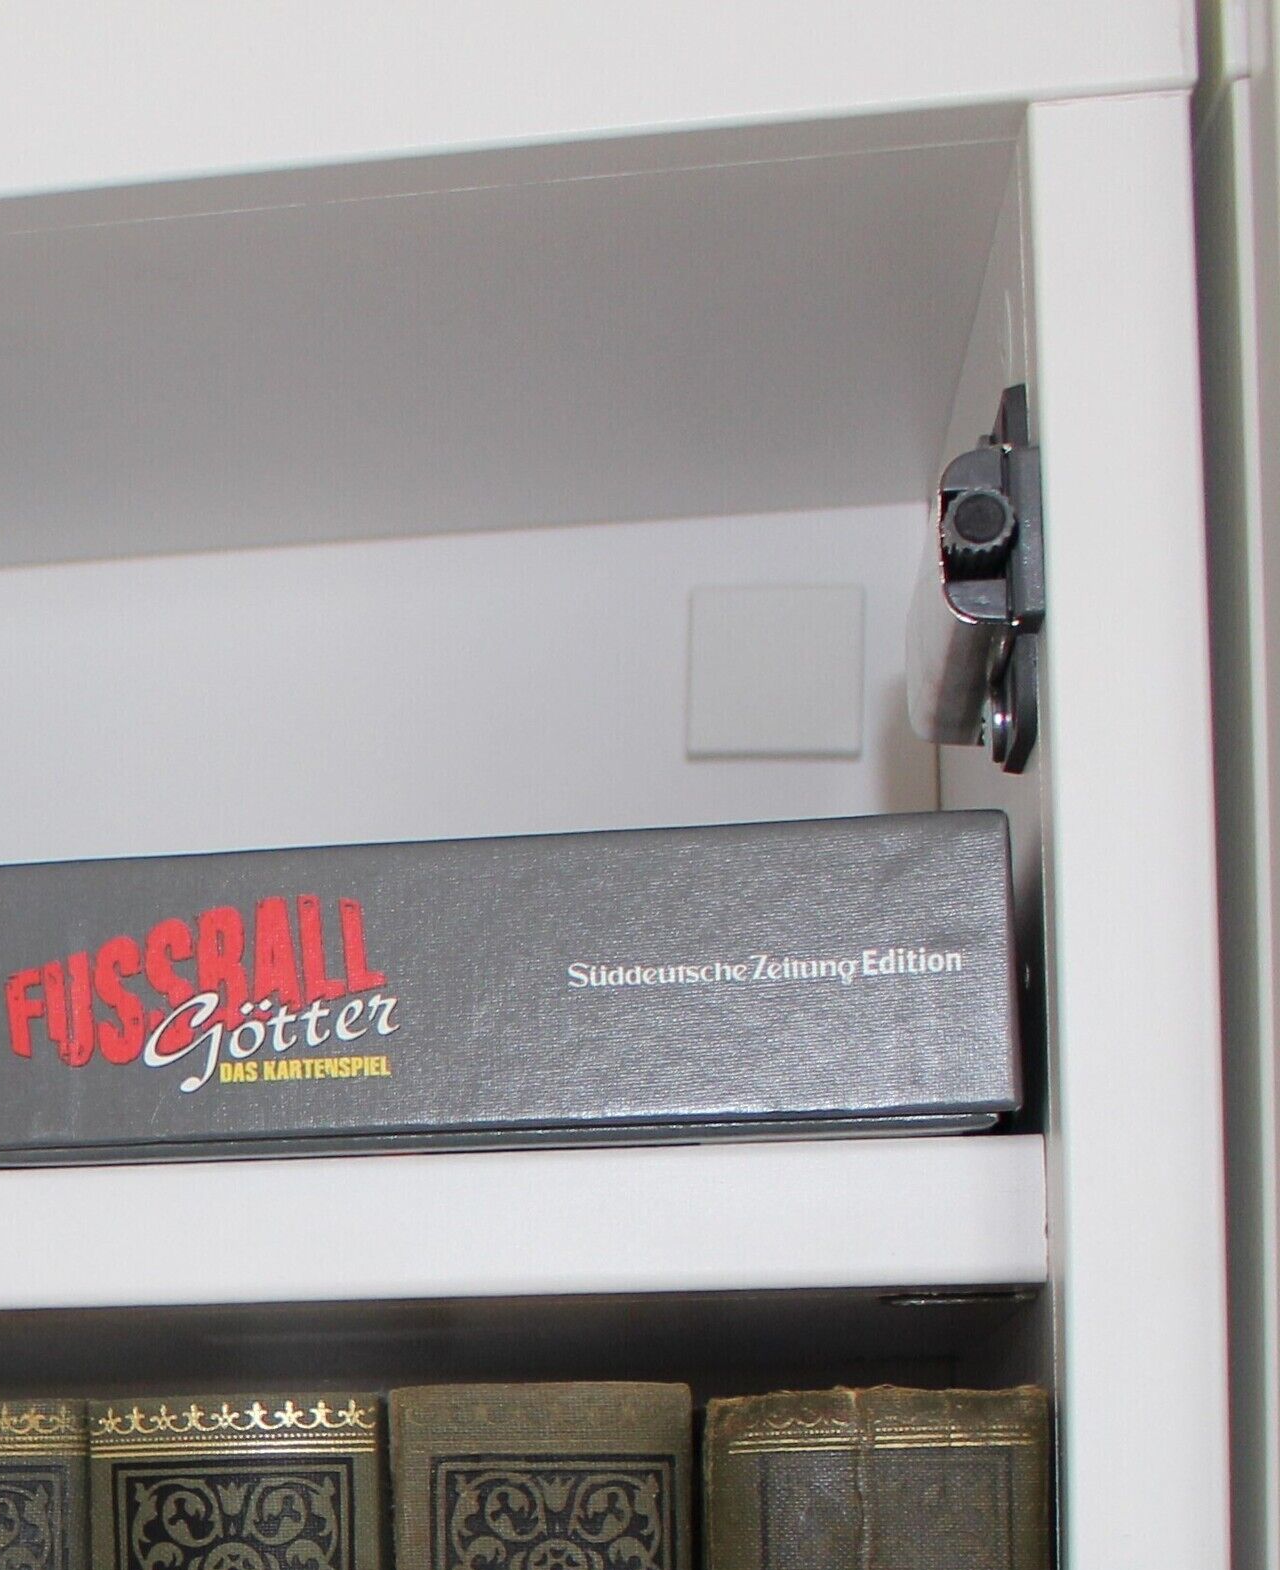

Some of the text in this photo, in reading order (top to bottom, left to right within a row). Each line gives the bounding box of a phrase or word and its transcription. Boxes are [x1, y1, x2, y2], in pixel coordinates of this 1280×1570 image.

[3, 893, 388, 1068] FUSSBALL
[568, 948, 964, 988] Süddeutsche Zeitung Edition
[142, 992, 401, 1093] Götter
[219, 1054, 392, 1084] DAS KARTENSPIEL
